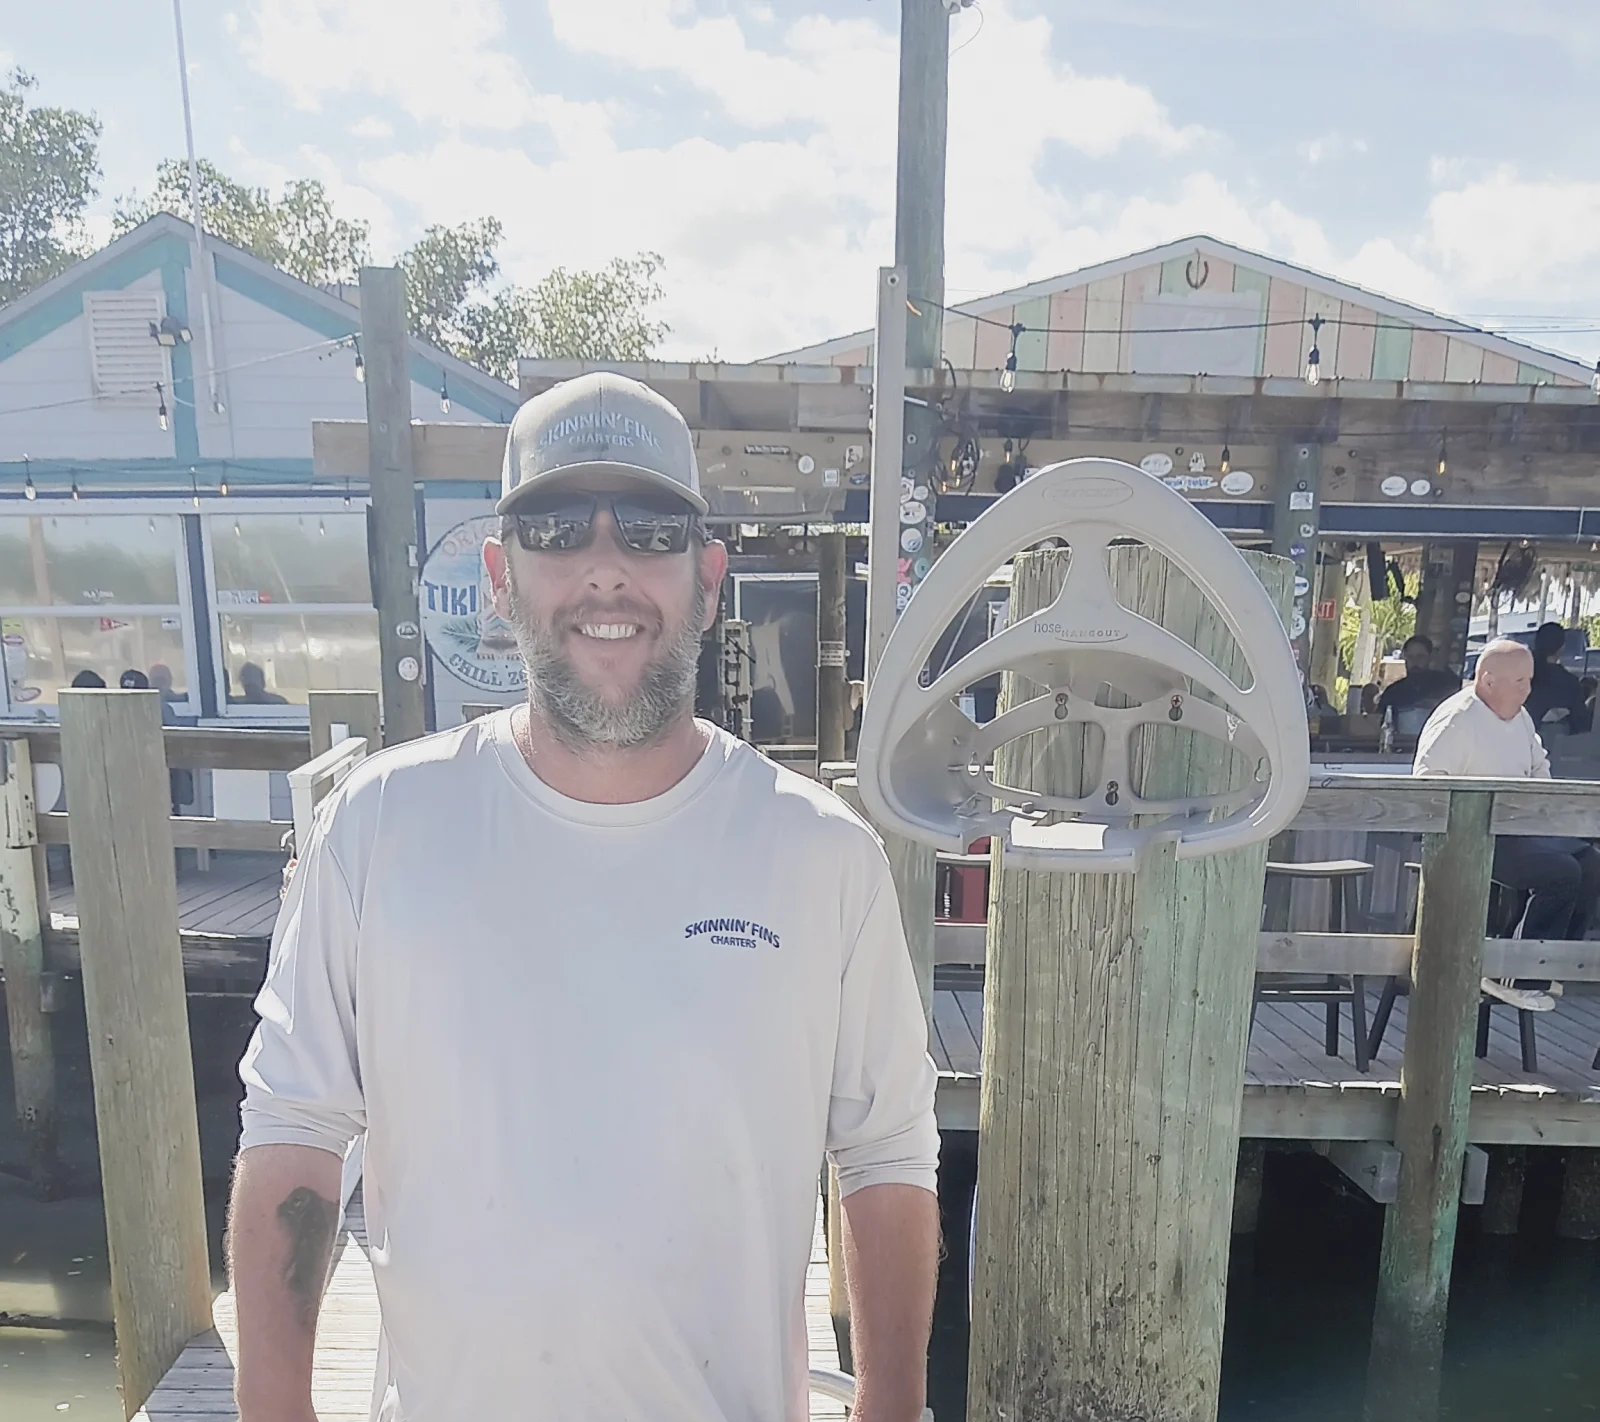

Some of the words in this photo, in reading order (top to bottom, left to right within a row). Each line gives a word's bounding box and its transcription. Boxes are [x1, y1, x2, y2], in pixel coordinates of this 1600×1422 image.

[539, 410, 622, 449] SKINNIN'
[568, 432, 635, 447] CHARTERS
[441, 521, 497, 556] ORIG
[424, 580, 477, 616] TIKI
[1034, 621, 1062, 633] hose
[1061, 629, 1121, 638] HANGOUT
[449, 653, 502, 686] CHILL
[684, 918, 750, 939] SKINNIN'
[751, 922, 781, 948] FINS
[710, 935, 757, 949] CHARTERS
